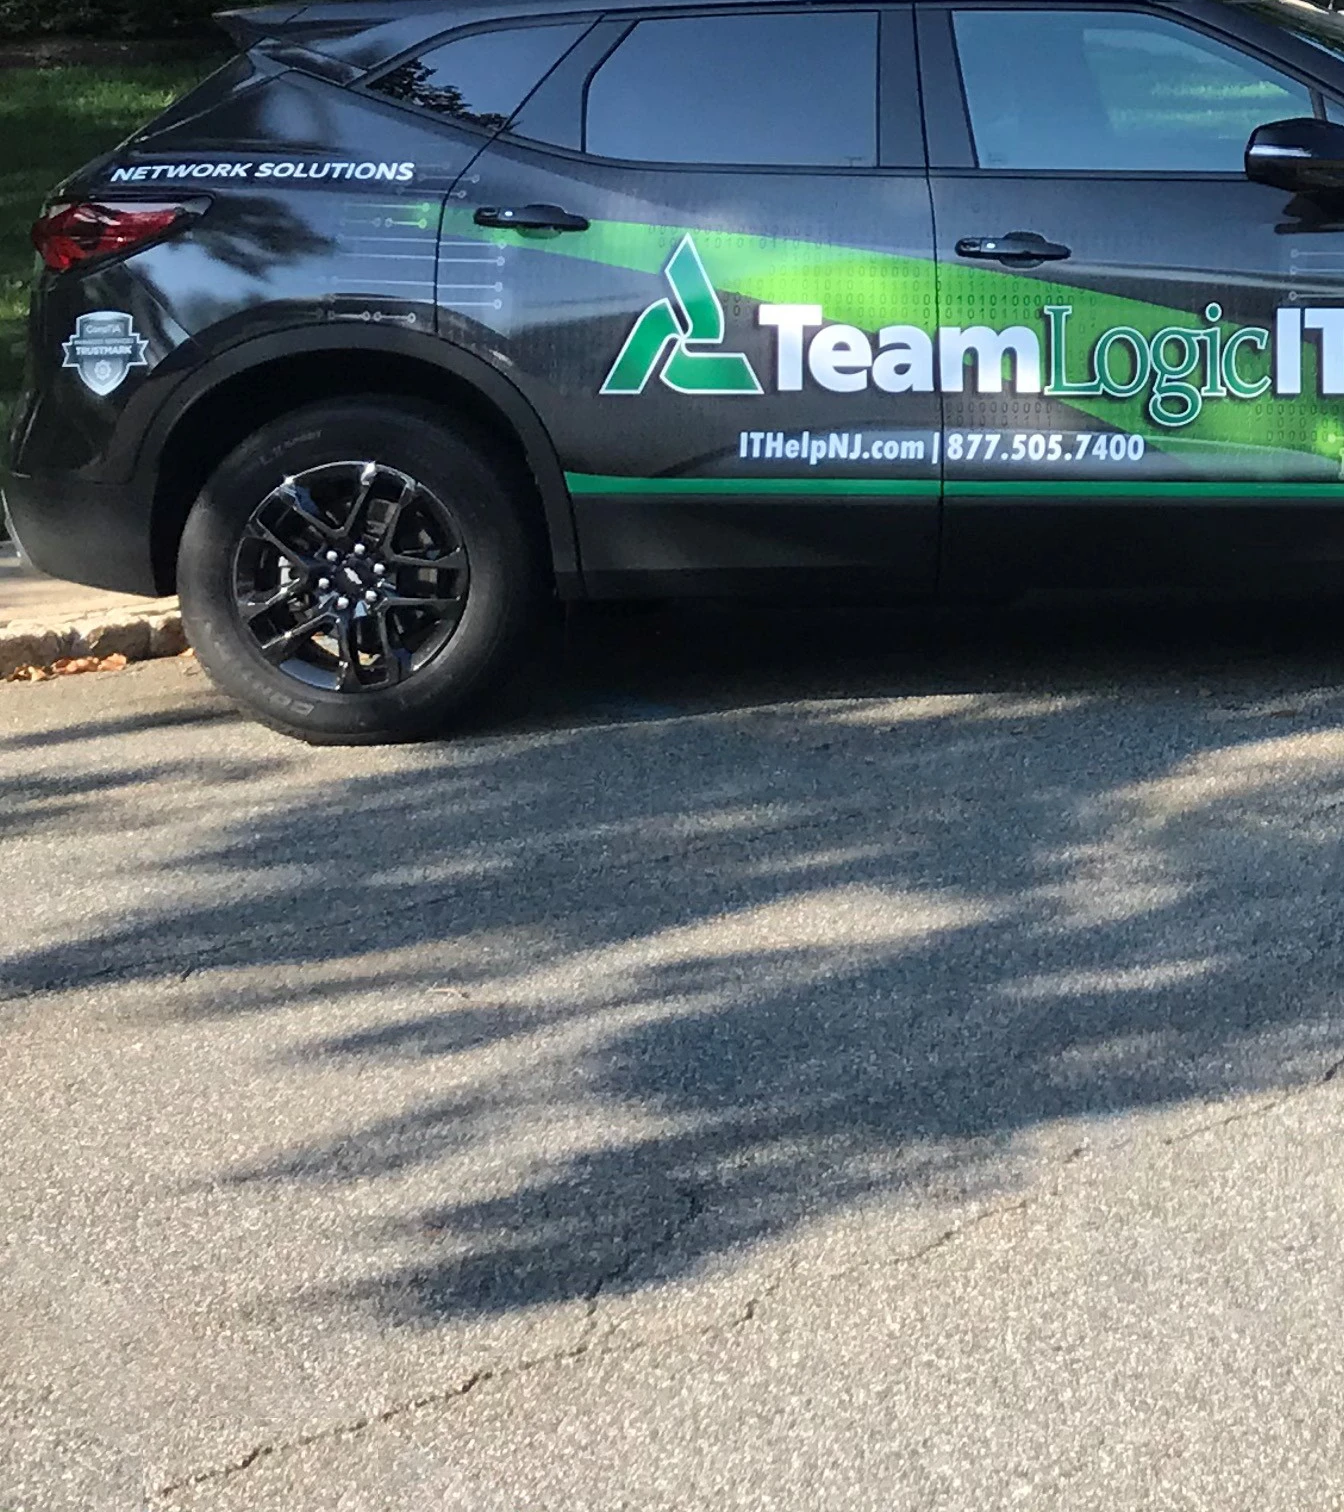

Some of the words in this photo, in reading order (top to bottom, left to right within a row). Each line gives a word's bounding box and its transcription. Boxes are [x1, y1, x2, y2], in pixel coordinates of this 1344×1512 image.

[110, 163, 253, 182] NETWORK
[254, 162, 415, 182] SOLUTIONS
[739, 431, 925, 465] ITHelpNJ.com
[947, 433, 1145, 462] 877.505.7400
